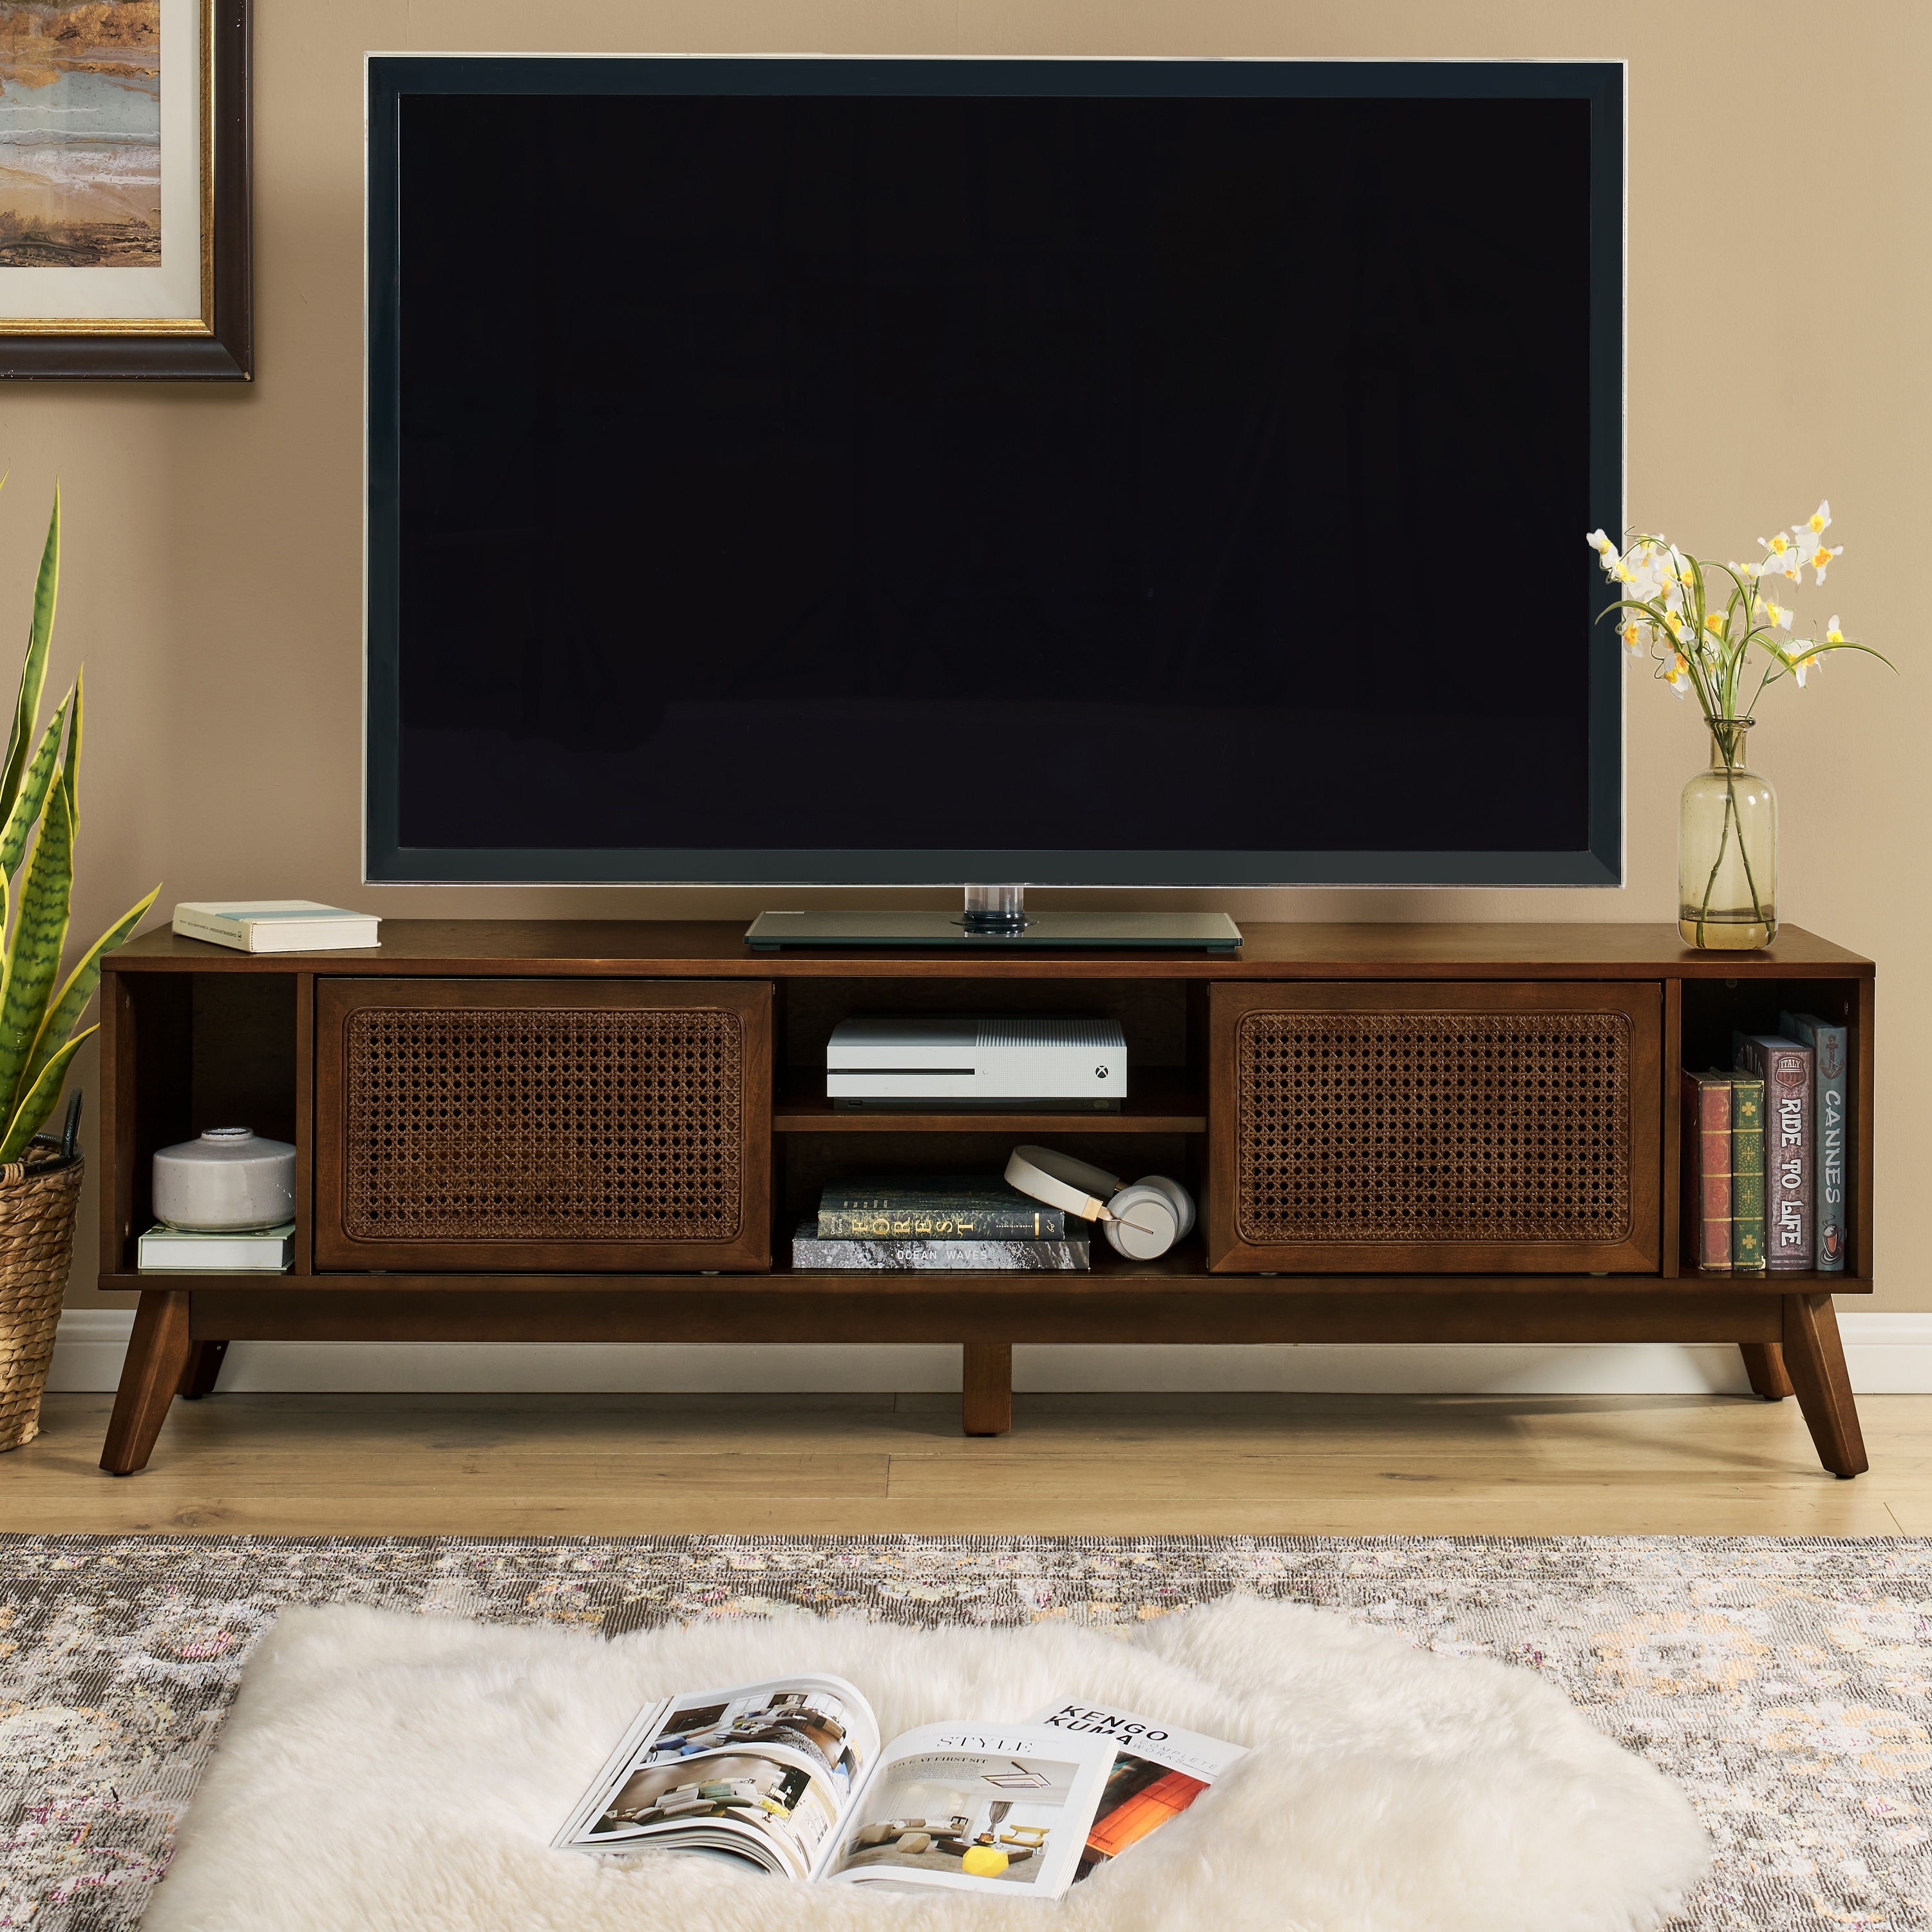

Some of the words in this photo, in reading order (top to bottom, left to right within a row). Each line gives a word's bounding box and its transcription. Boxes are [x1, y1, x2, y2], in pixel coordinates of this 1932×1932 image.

[1780, 1072, 1801, 1082] 1977
[1781, 1059, 1801, 1068] ITALY
[1777, 1099, 1802, 1147] RIDE
[1825, 1090, 1841, 1204] CANNES
[1781, 1159, 1802, 1189] TO
[851, 1217, 974, 1236] FOREST
[1777, 1200, 1804, 1246] LIFE
[897, 1250, 937, 1260] OCEAN
[946, 1250, 987, 1260] WAVES
[1043, 1716, 1133, 1745] KUMA
[1059, 1705, 1169, 1741] KENGO
[937, 1736, 1032, 1752] STYLE
[1133, 1743, 1184, 1764] WORKS
[1140, 1740, 1218, 1770] COMPLETE
